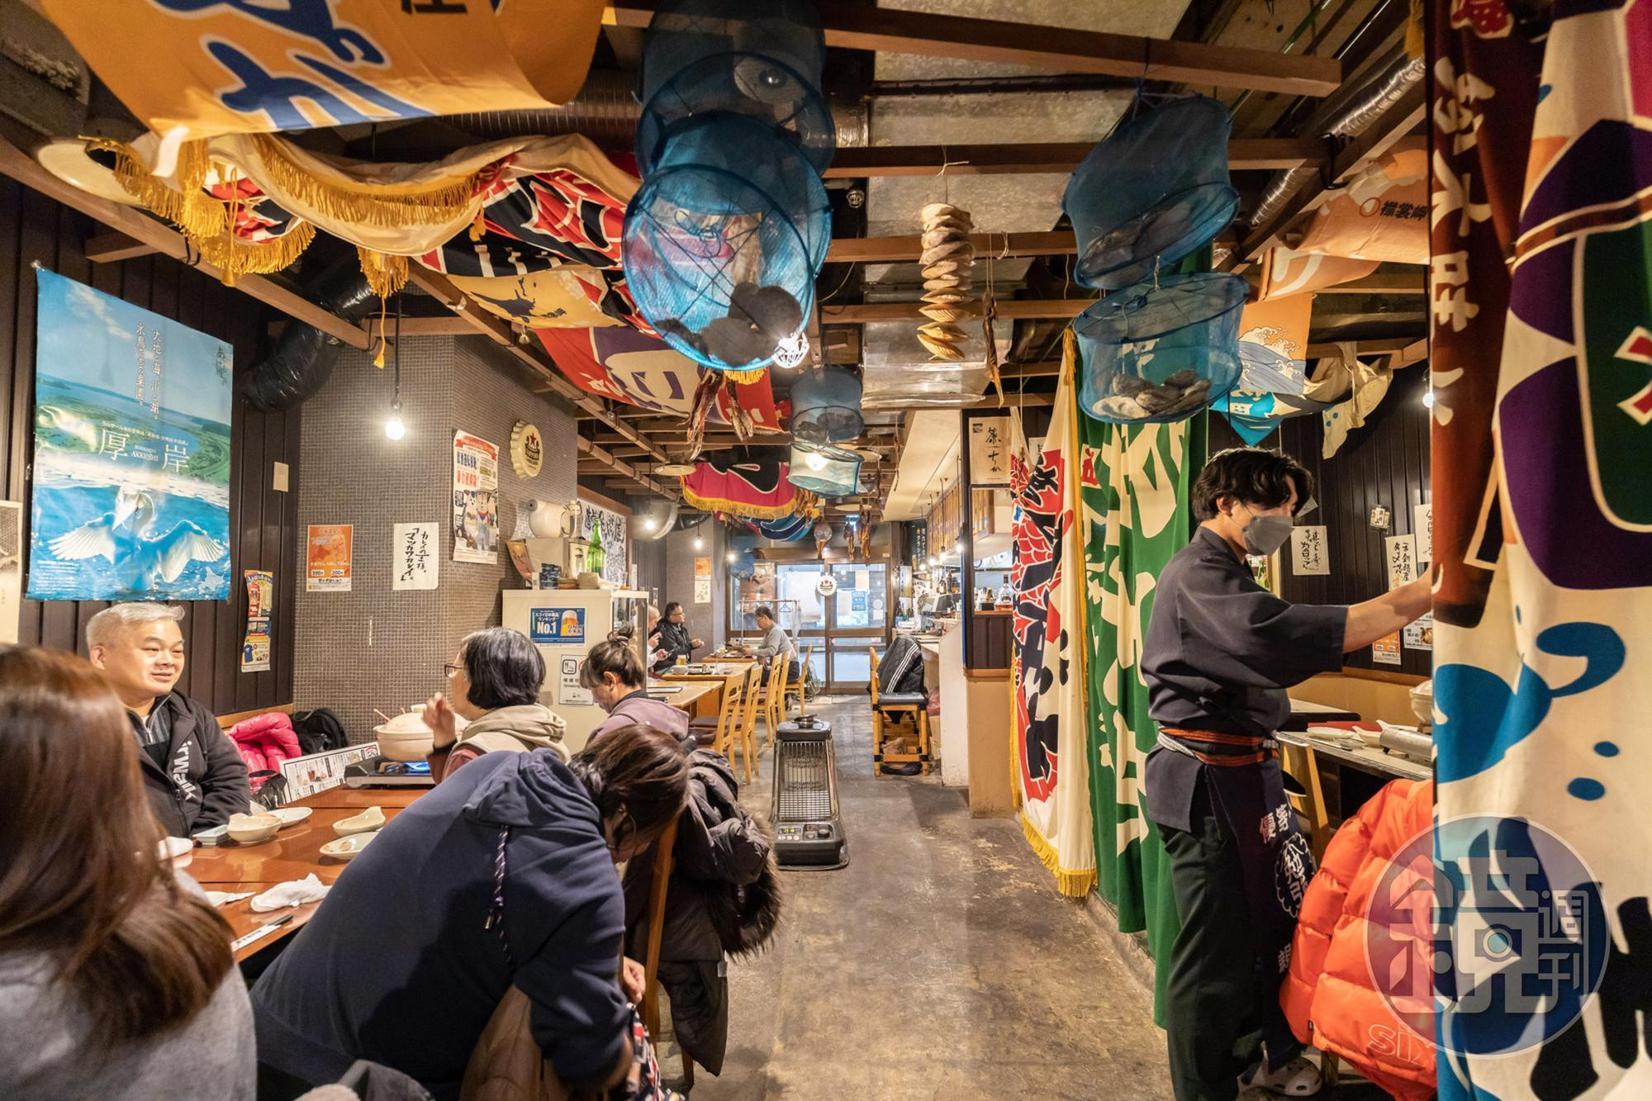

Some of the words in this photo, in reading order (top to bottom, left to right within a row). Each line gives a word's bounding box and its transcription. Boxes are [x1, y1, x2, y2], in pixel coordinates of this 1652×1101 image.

[99, 429, 130, 460] 厚
[162, 444, 190, 472] 岸
[537, 621, 557, 635] No.1
